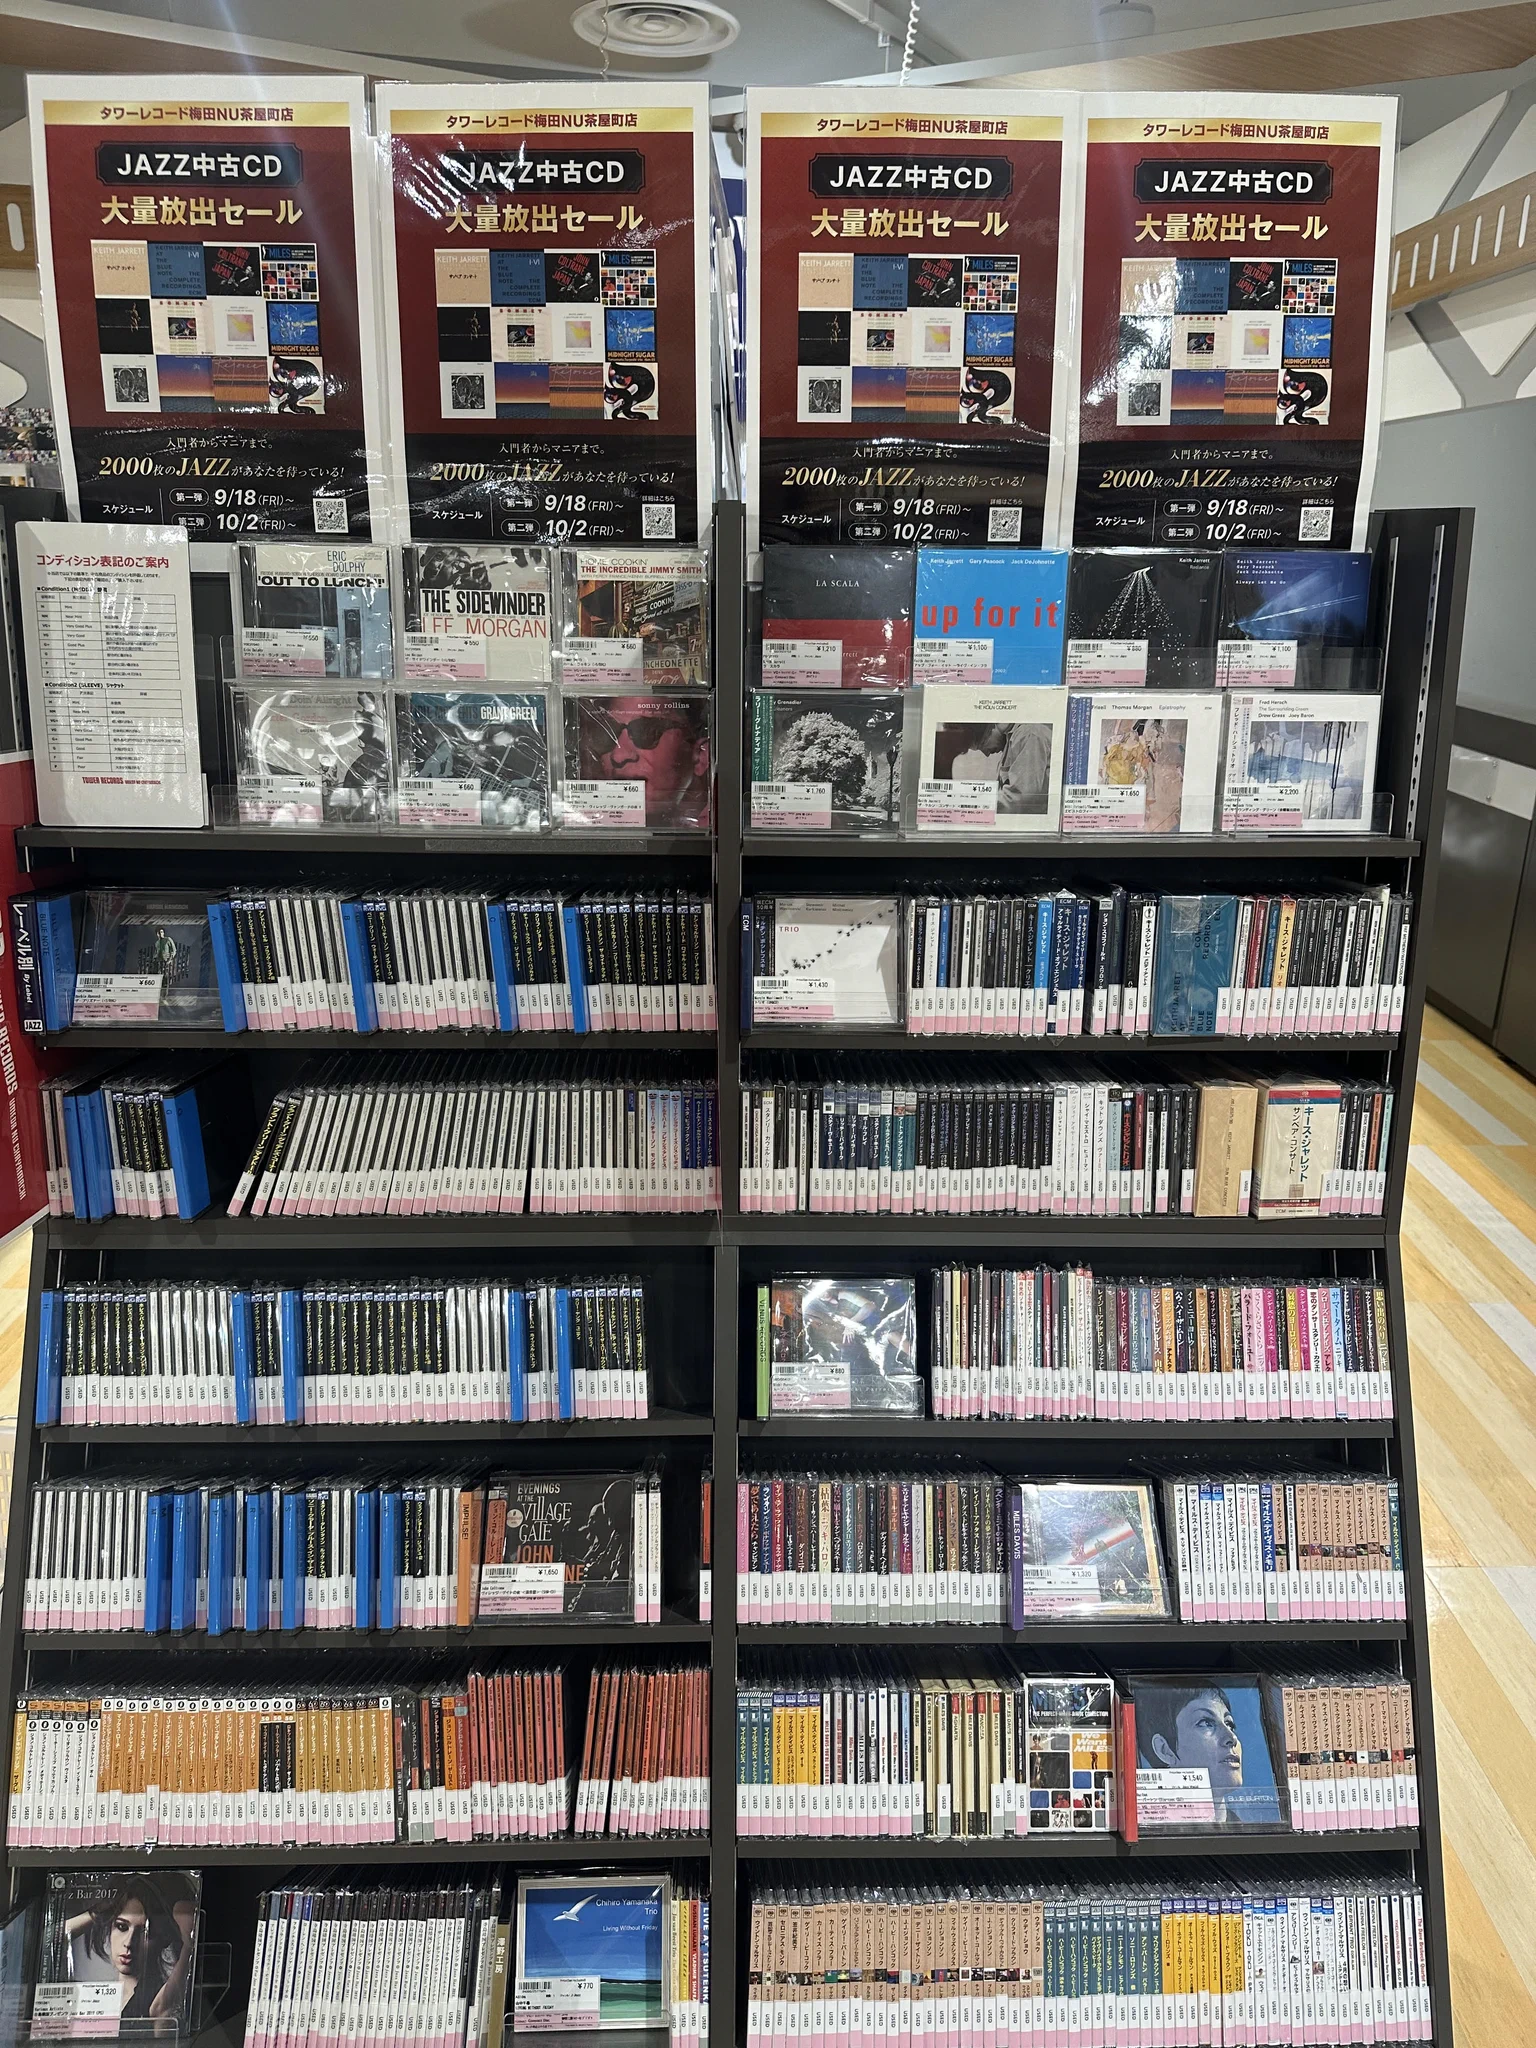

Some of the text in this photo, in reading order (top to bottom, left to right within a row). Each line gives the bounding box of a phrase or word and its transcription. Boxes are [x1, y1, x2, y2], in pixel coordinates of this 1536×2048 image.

[100, 106, 294, 123] タワーレコード梅田NU茶屋町店
[446, 113, 638, 128] タワーレコード梅田NU茶屋町店
[816, 118, 1008, 135] タワーレコード梅田NU茶屋町店
[1143, 123, 1329, 140] タワーレコード梅田NU茶屋町店
[117, 153, 283, 178] JAZZ中古CD
[466, 159, 625, 185] JAZZ中古CD
[829, 165, 993, 190] JAZZ中古CD
[1154, 169, 1314, 194] JAZZ中古CD
[100, 195, 304, 226] 大量放出セール
[445, 204, 643, 234] 大量放出セール
[810, 208, 1010, 238] 大量放出セール
[1134, 213, 1329, 243] 大量放出セール
[175, 492, 203, 502] 第一弾
[506, 498, 534, 508] 第一弾
[102, 504, 154, 515] スケジュール
[432, 509, 483, 520] スケジュール
[855, 502, 881, 512] 第一弾
[1169, 503, 1196, 513] 第一弾
[177, 517, 205, 528] 第二弾
[781, 513, 832, 524] スケジュール
[1095, 516, 1146, 527] スケジュール
[507, 522, 535, 533] 第二弾
[854, 526, 881, 537] 第二弾
[1168, 527, 1194, 538] 第二弾
[36, 554, 170, 569] コンディション表記のご案内
[327, 551, 347, 562] ERIC
[333, 561, 366, 573] DOLPHY
[600, 566, 646, 574] INCREDIBLE
[649, 566, 675, 574] JIMMY
[677, 566, 702, 574] SMITH
[298, 577, 320, 586] TO
[831, 580, 860, 588] SCALA
[422, 590, 546, 616] THE SIDEWINDER
[922, 597, 1059, 633] up for it
[466, 618, 547, 638] MORGAN
[480, 706, 538, 720] GRANT GREEN
[637, 702, 661, 710] sonny
[742, 914, 750, 931] ECM
[12, 902, 35, 971] レーベル別
[1062, 908, 1072, 972] キース・ジャレット
[1278, 915, 1291, 970] キース・ジャレット
[24, 973, 33, 1003] By Label
[25, 1021, 42, 1030] JAZZ
[1288, 1107, 1301, 1175] サンベア・コンサート
[1299, 1106, 1315, 1182] キース・ジャレット
[759, 1299, 767, 1324] VENUS
[1332, 1291, 1343, 1346] サマータイム
[517, 1483, 561, 1495] EVENINGS
[820, 1487, 830, 1513] 枯葉
[462, 1503, 470, 1540] IMPULSE!
[1191, 1498, 1199, 1553] マイルス・デイビス
[1228, 1498, 1236, 1543] マイルス・デイビス
[519, 1521, 552, 1543] GATE
[516, 1545, 554, 1563] JOHN
[1013, 1537, 1021, 1560] DAVIS
[538, 1568, 559, 1576] ¥1,650
[1076, 1738, 1108, 1746] Want
[1081, 1732, 1101, 1740] We
[1074, 1745, 1113, 1753] MILES
[1182, 1774, 1203, 1782] ¥1,540
[77, 1888, 118, 1900] Bar 2017
[596, 1898, 658, 1907] Chihiro Yamanaka
[644, 1908, 658, 1916] Trio
[602, 1924, 658, 1934] Living Without Friday
[703, 1907, 711, 1947] LIVE AT
[95, 1988, 117, 1996] ¥1,320
[577, 1982, 594, 1990] ¥770
